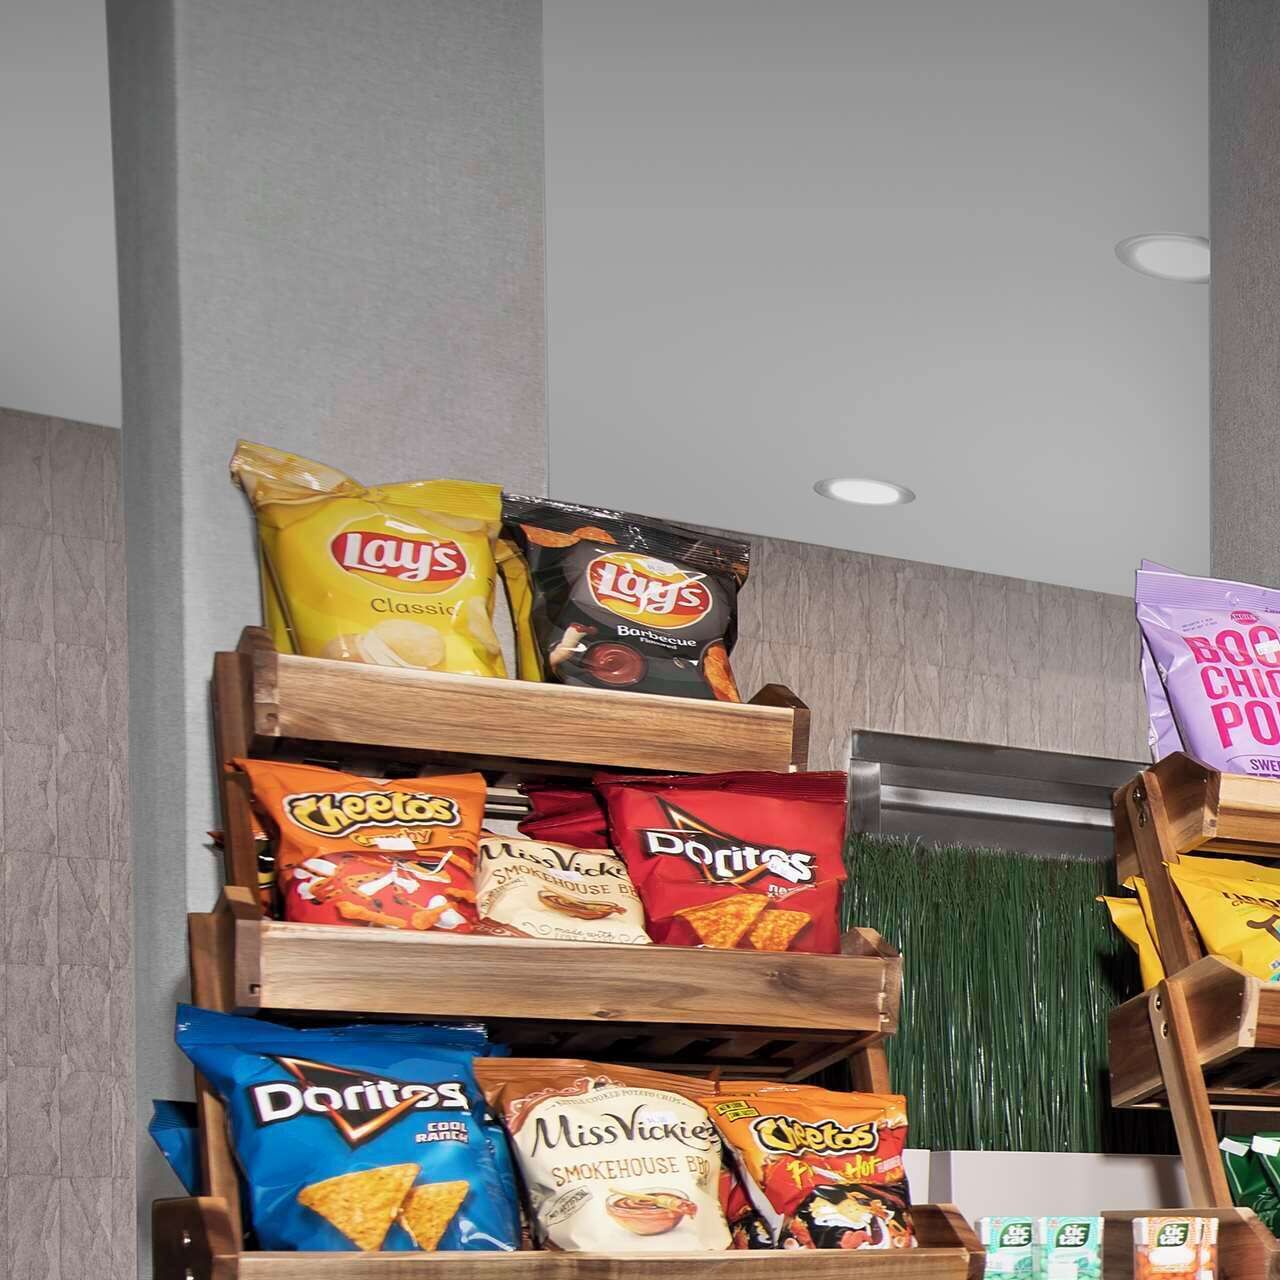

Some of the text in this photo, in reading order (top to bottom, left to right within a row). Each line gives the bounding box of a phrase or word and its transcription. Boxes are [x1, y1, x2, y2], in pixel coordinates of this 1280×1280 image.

[341, 531, 462, 583] Lay's
[597, 562, 702, 614] Lay's
[370, 598, 458, 617] Classic
[617, 625, 697, 647] Barbecue
[293, 795, 453, 833] Cheetos
[646, 830, 814, 884] Doritos
[255, 1080, 469, 1122] Doritos
[428, 1122, 467, 1132] COOL
[531, 1115, 617, 1157] Miss
[757, 1118, 874, 1150] Cheetos
[416, 1131, 468, 1144] RANCH
[552, 1156, 680, 1187] SMOKEHOUSE
[1003, 1234, 1031, 1245] tac
[1008, 1224, 1030, 1236] tic
[1059, 1234, 1086, 1245] tac
[1065, 1224, 1087, 1236] tic
[1159, 1234, 1185, 1246] tac
[1165, 1224, 1186, 1236] tic
